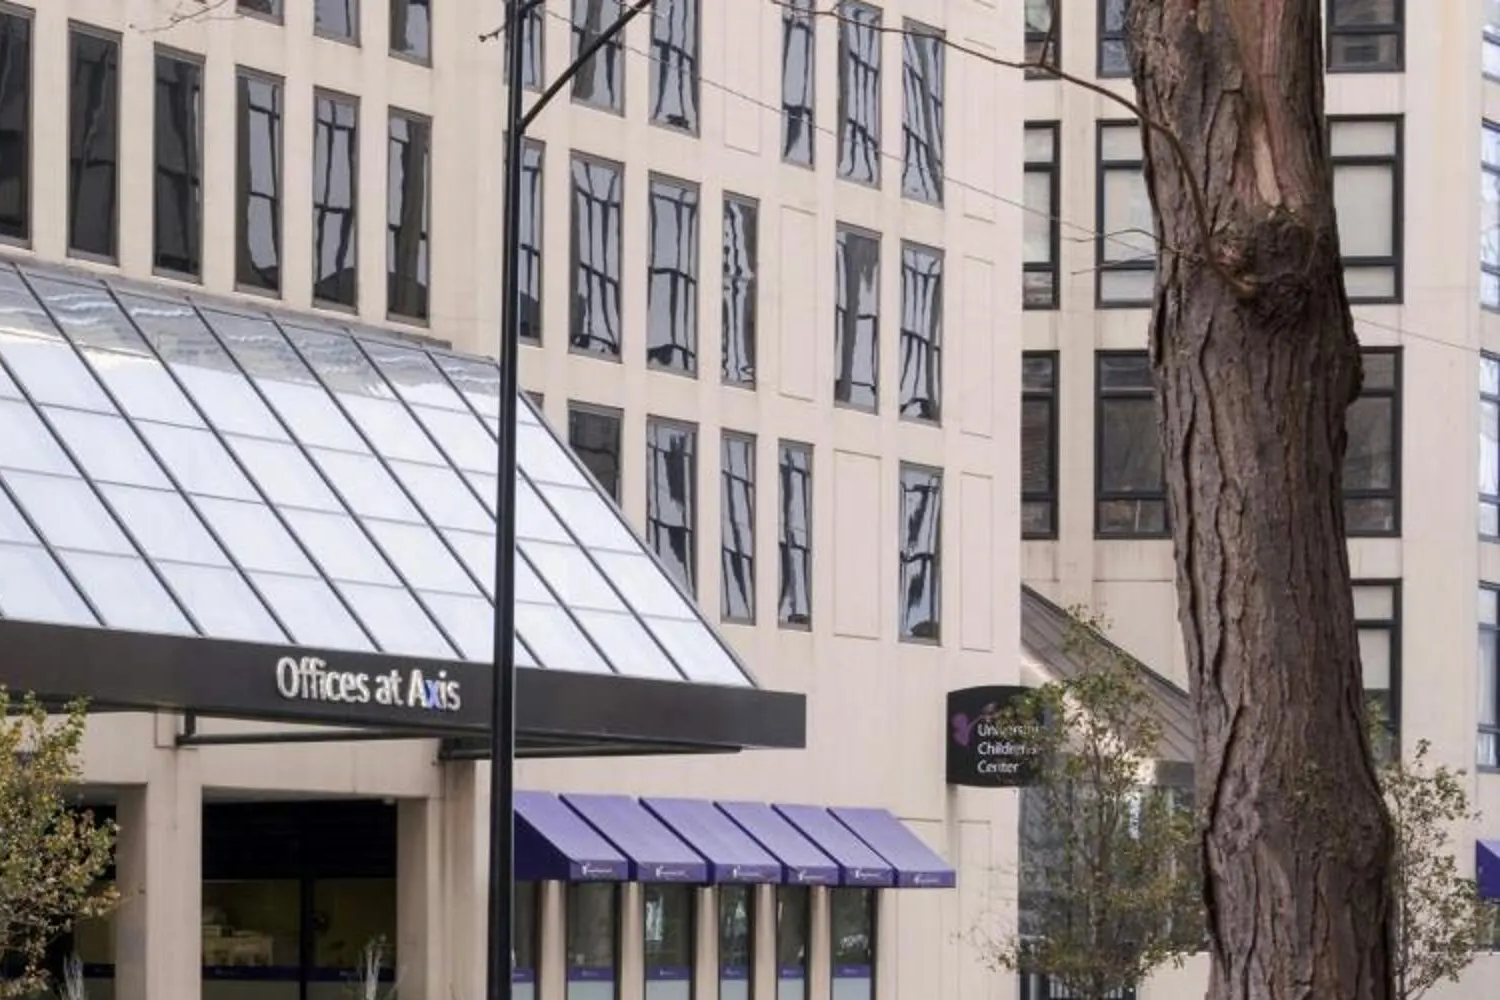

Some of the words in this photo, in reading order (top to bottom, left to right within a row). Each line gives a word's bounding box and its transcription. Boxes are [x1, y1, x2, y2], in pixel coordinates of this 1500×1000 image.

[275, 656, 371, 703] Offices
[375, 669, 404, 705] at
[407, 668, 462, 712] Axis
[977, 760, 1020, 774] Center
